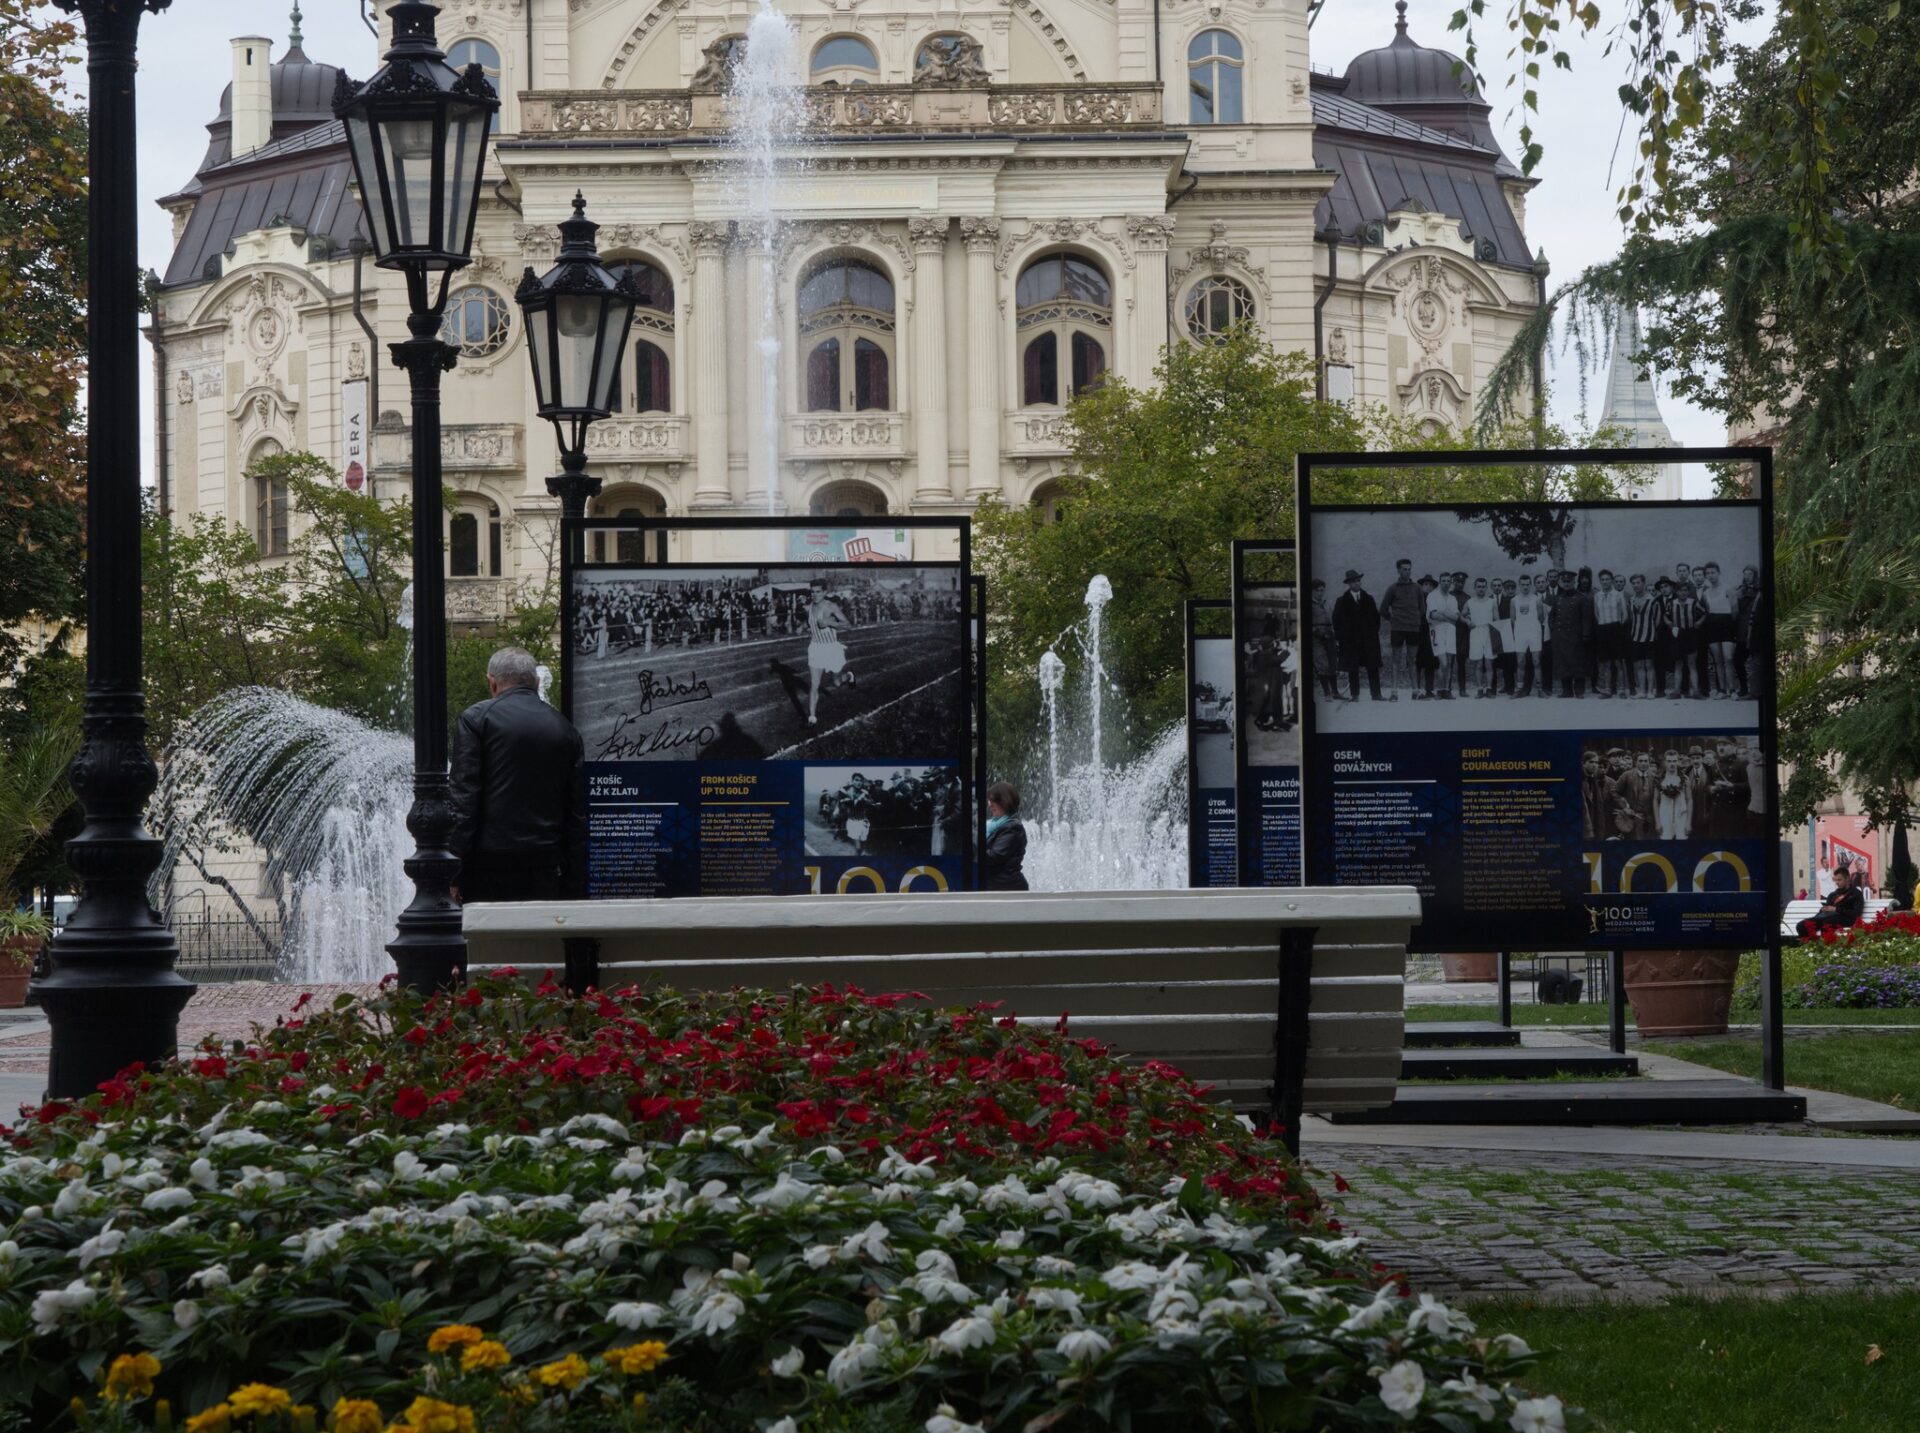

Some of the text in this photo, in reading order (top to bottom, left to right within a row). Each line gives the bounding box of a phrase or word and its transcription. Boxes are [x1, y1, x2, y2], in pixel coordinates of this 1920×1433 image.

[1334, 750, 1361, 760] OSEM
[1462, 748, 1491, 759] EIGHT
[1334, 760, 1392, 773] ODVÁŽNYCH
[1462, 760, 1551, 771] COURAGEOUS MEN
[590, 775, 622, 785] Z KOŠÍC
[701, 773, 757, 784] FROM KOŠICE
[590, 786, 639, 796] AŽ K ZLATU
[701, 786, 750, 796] UP TO GOLD
[1262, 790, 1299, 799] SLOBODY
[1208, 798, 1226, 807] ÚTOK
[1604, 907, 1632, 920] 100
